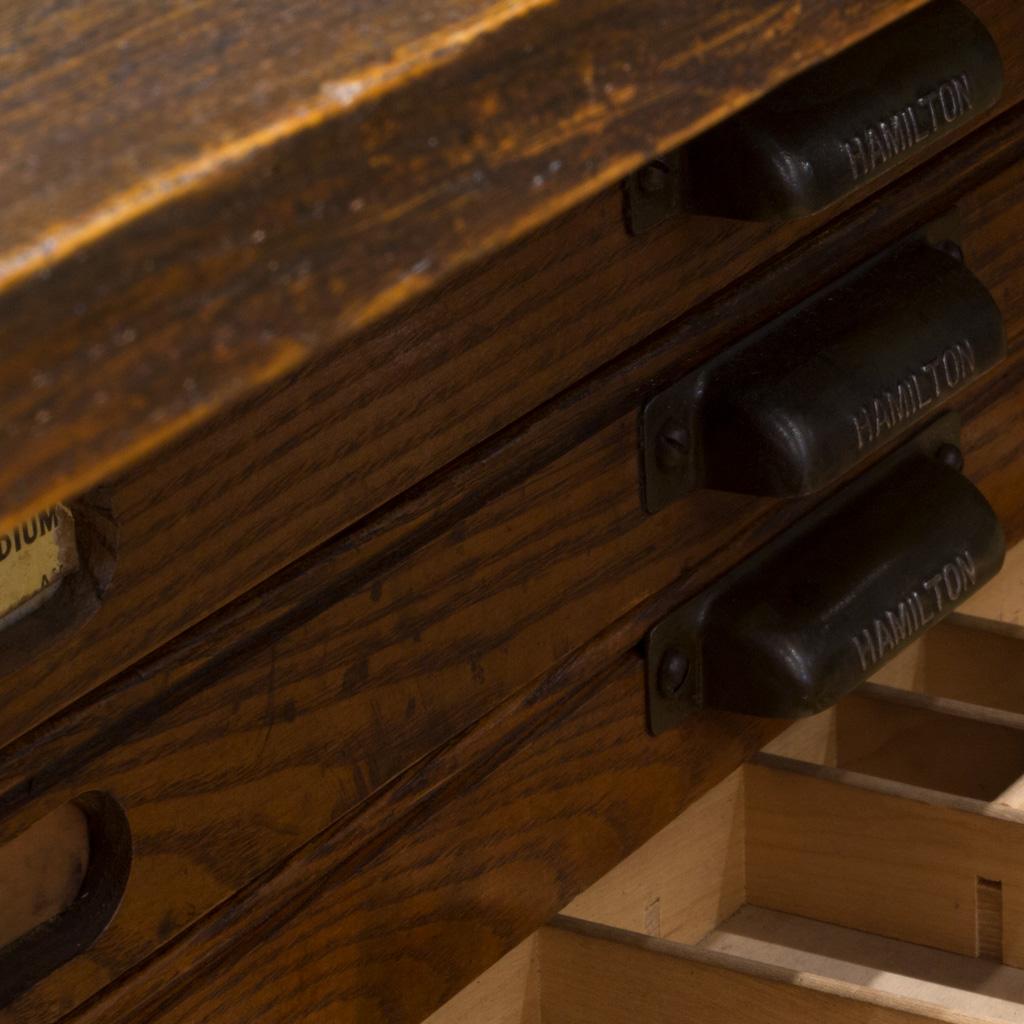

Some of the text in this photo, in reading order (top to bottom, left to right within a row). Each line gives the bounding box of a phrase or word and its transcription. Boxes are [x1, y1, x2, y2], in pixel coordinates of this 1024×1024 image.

[843, 75, 974, 180] HAMILTON
[853, 340, 976, 449] HAMILTON
[853, 550, 976, 671] HAMILTON
